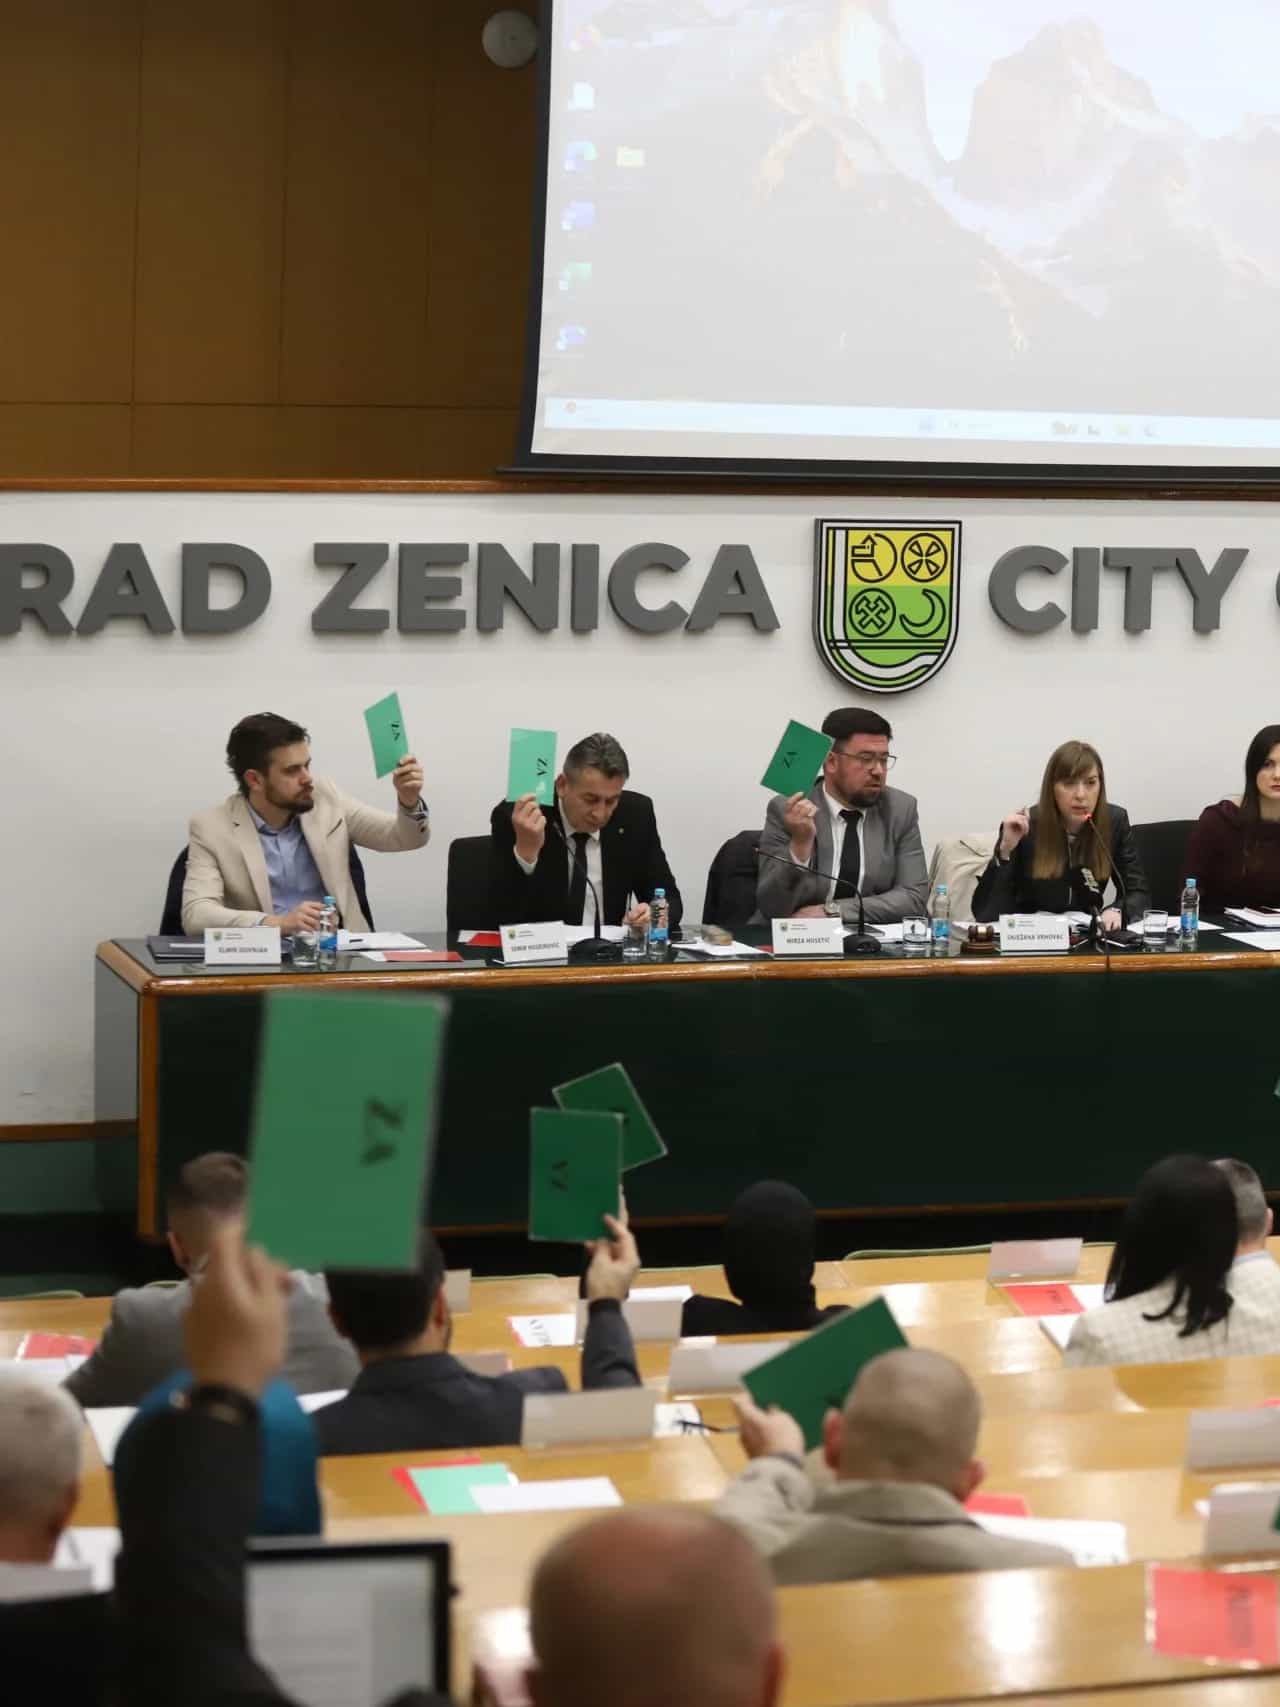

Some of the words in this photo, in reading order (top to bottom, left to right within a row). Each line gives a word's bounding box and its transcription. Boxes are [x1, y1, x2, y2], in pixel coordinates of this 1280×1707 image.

[0, 541, 272, 638] RAD
[311, 541, 781, 634] ZENICA
[988, 545, 1250, 634] CITY
[536, 757, 549, 777] ZA
